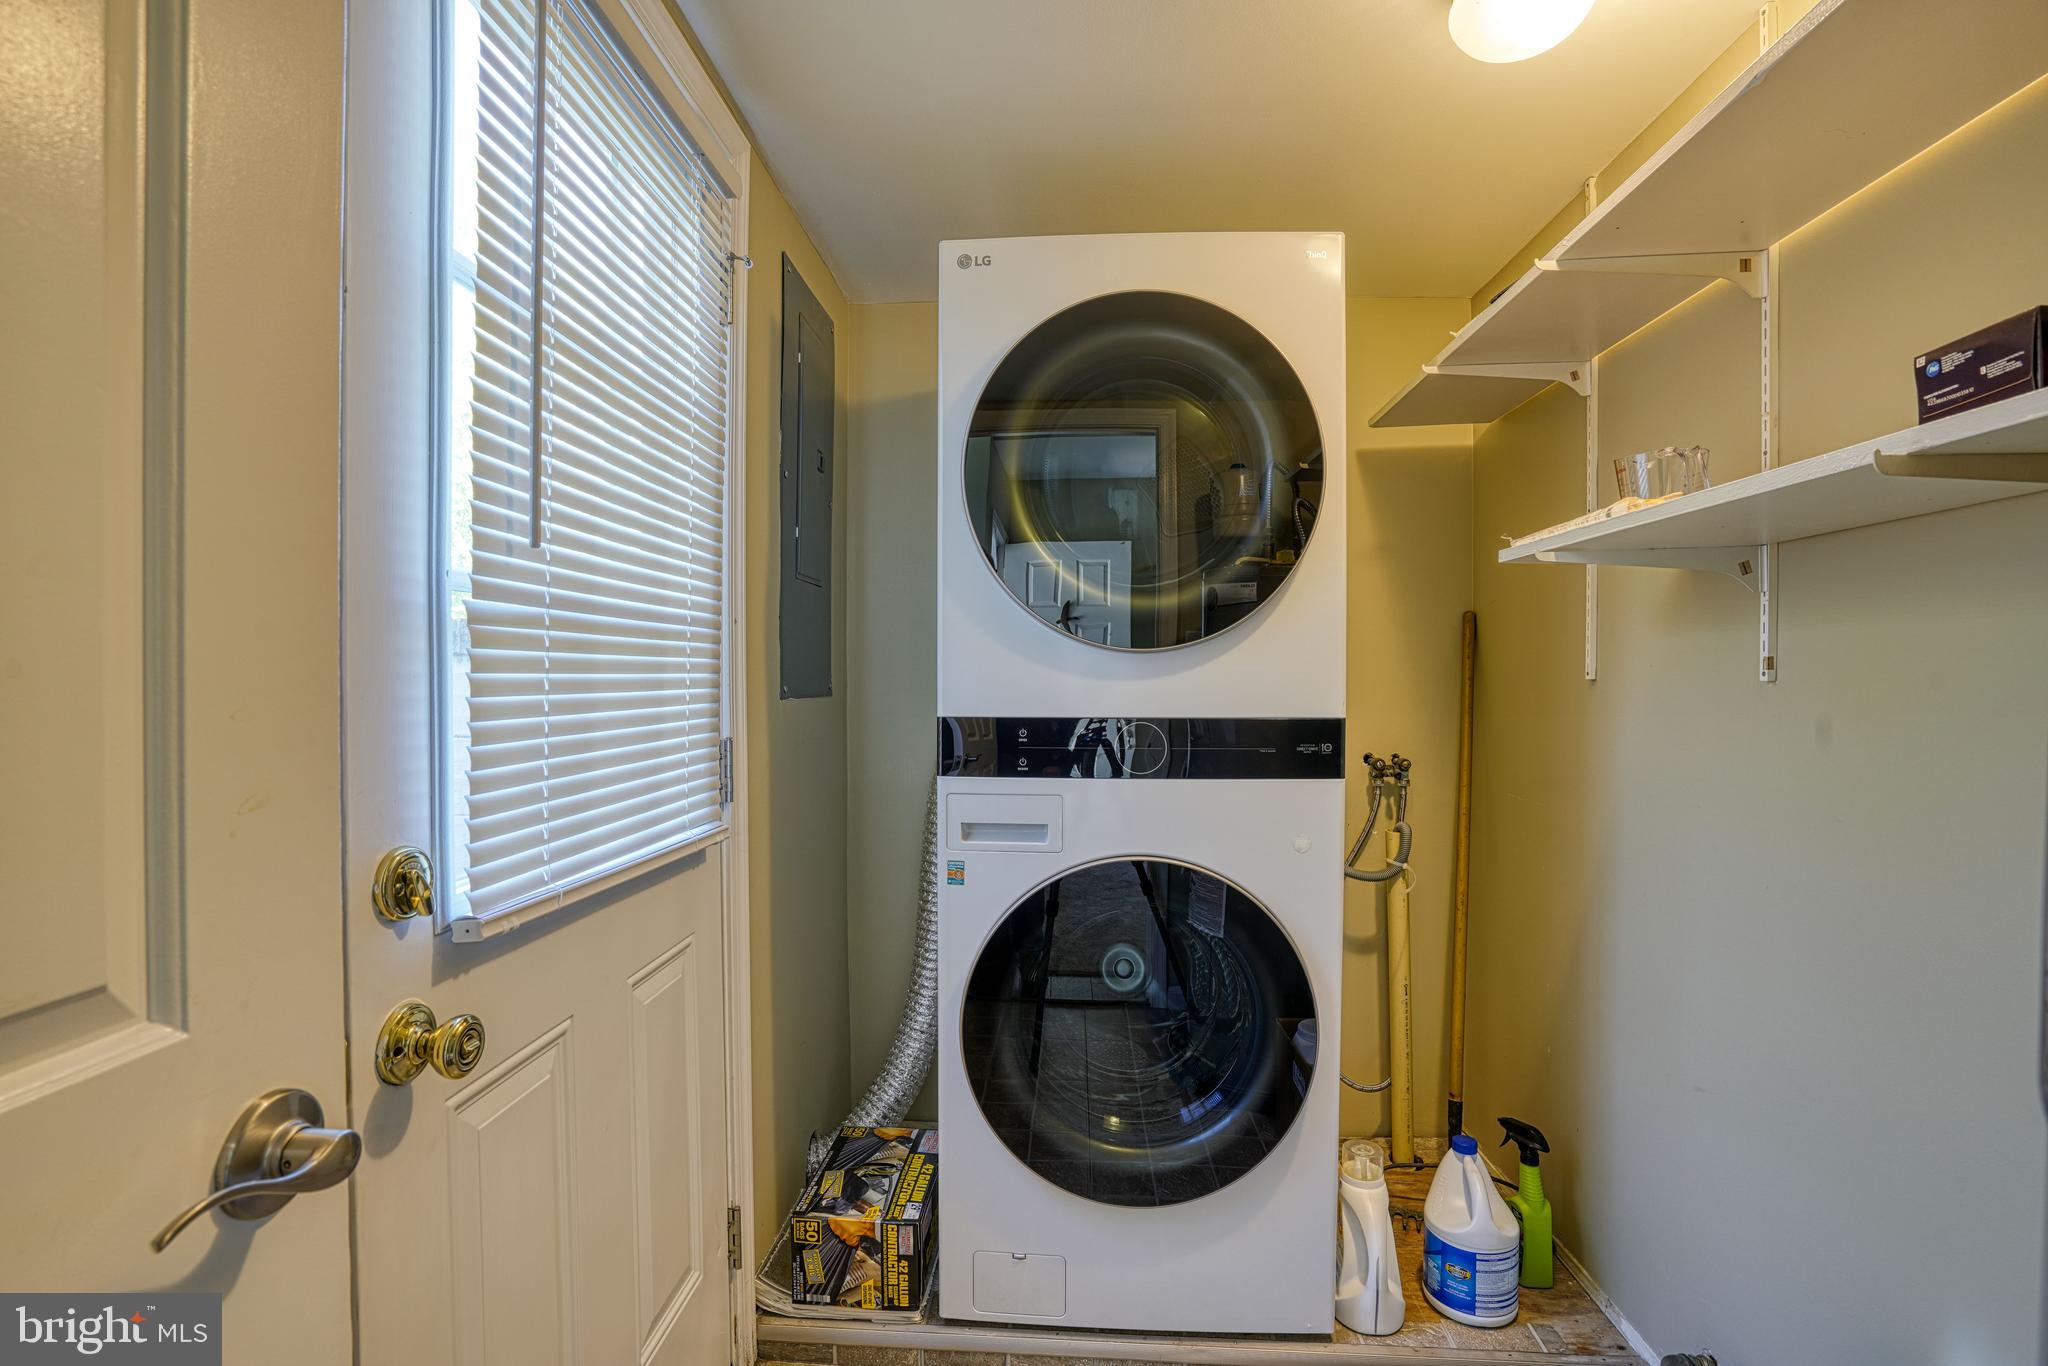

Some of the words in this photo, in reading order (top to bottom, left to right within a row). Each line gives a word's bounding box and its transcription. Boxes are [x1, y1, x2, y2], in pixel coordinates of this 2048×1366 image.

[897, 1154, 926, 1206] CONTRACTOR
[920, 1163, 935, 1174] 42
[910, 1174, 931, 1202] GALLON
[805, 1221, 818, 1242] 50
[887, 1224, 898, 1285] CONTRACTOR
[899, 1260, 909, 1273] 42
[899, 1275, 909, 1307] GALLON
